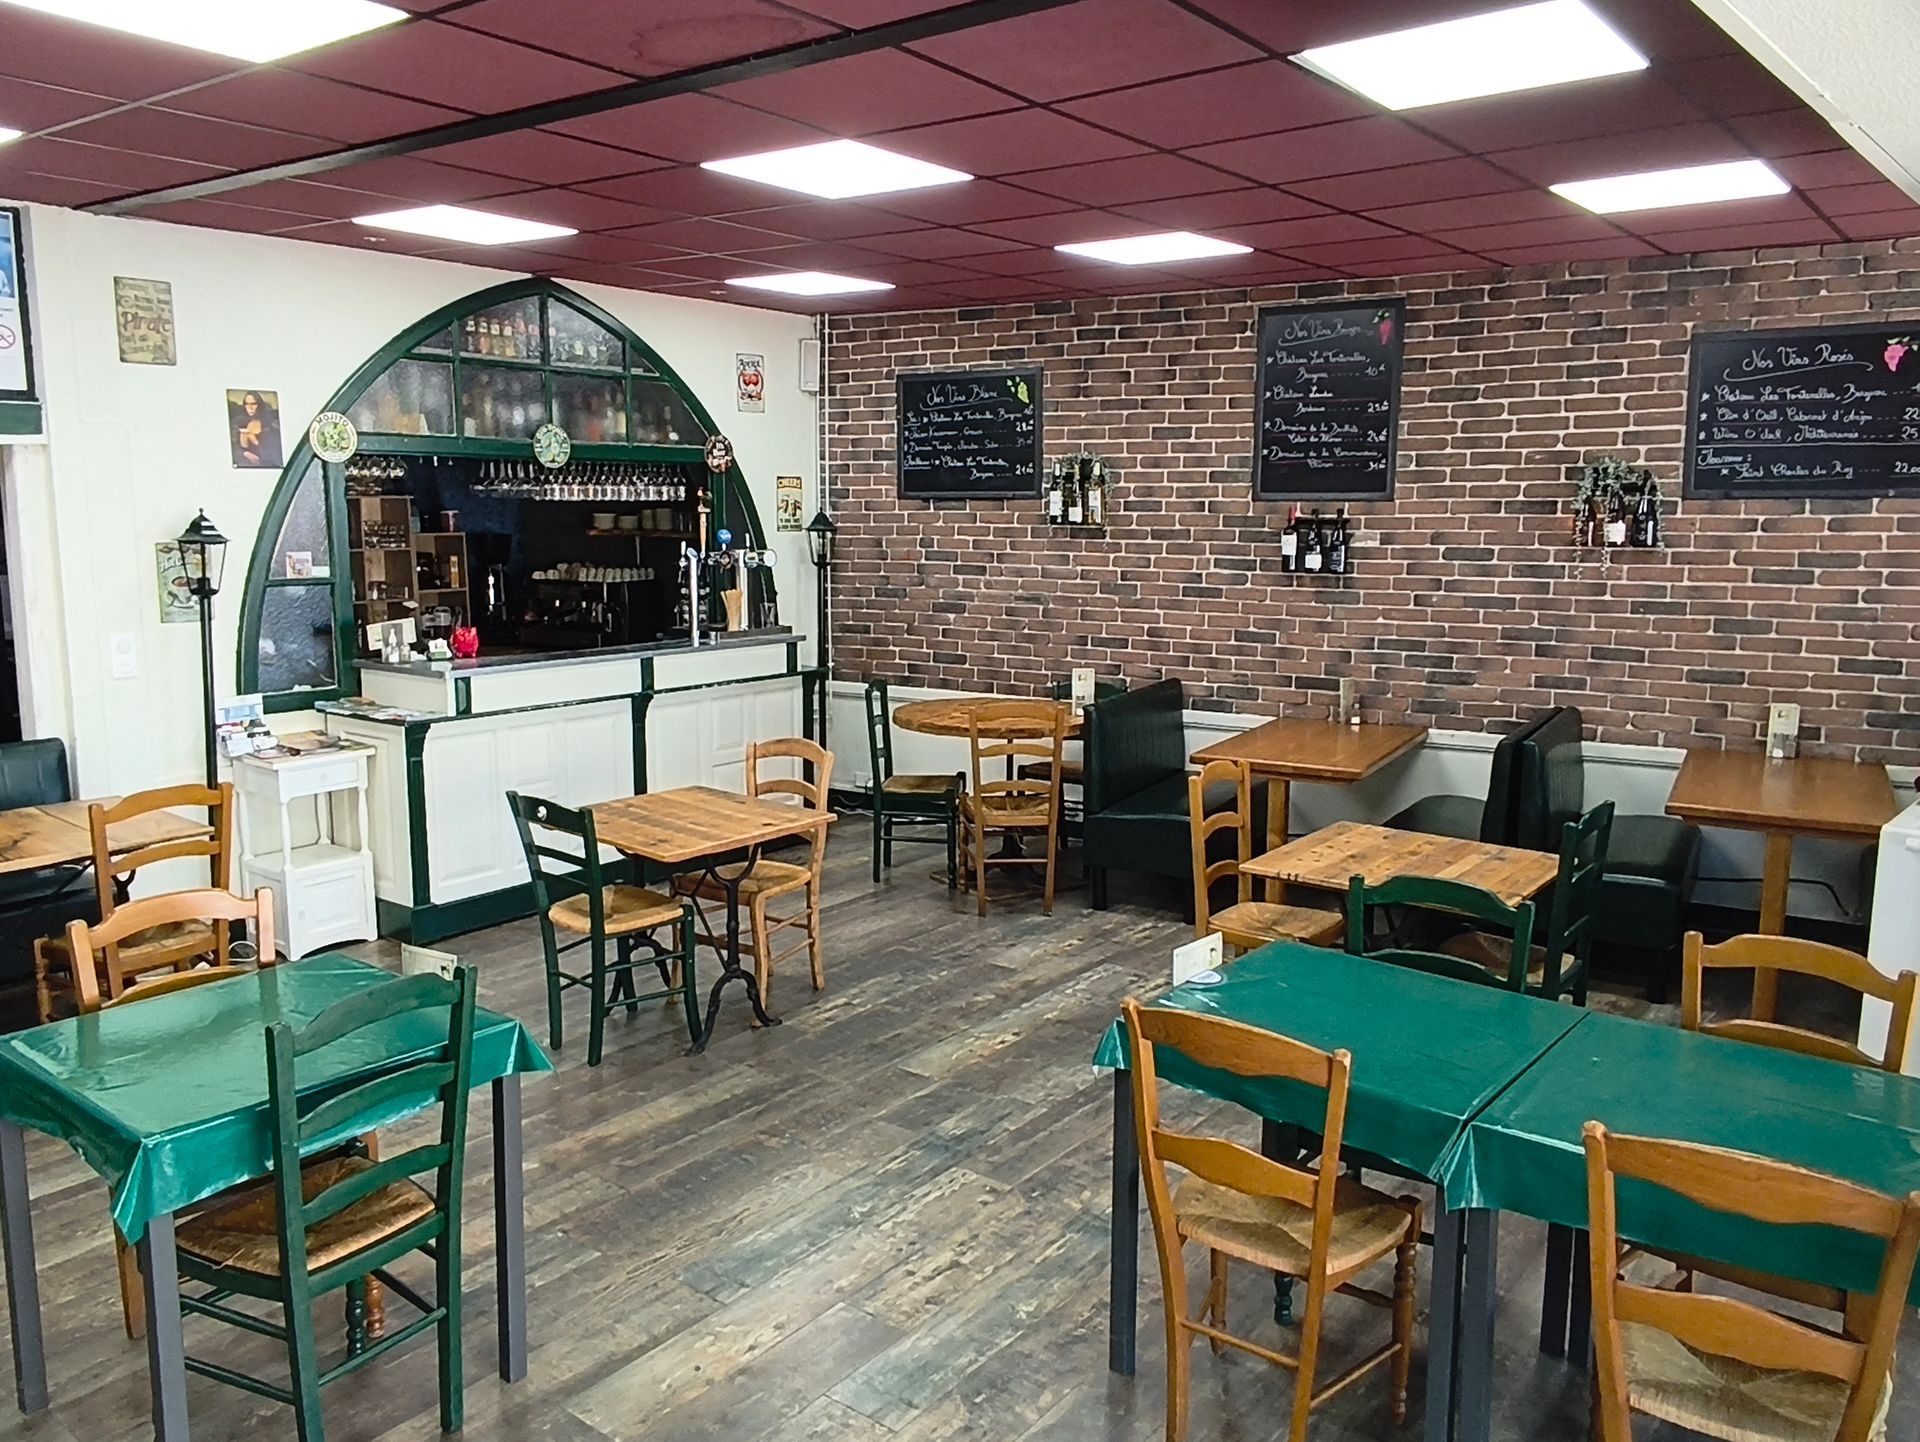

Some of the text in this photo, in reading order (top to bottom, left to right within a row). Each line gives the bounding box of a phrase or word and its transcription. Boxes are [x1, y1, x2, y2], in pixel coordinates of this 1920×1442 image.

[121, 311, 171, 334] Pirate
[1742, 343, 1853, 371] Nos Vins Rosés
[315, 414, 349, 427] MOJITO
